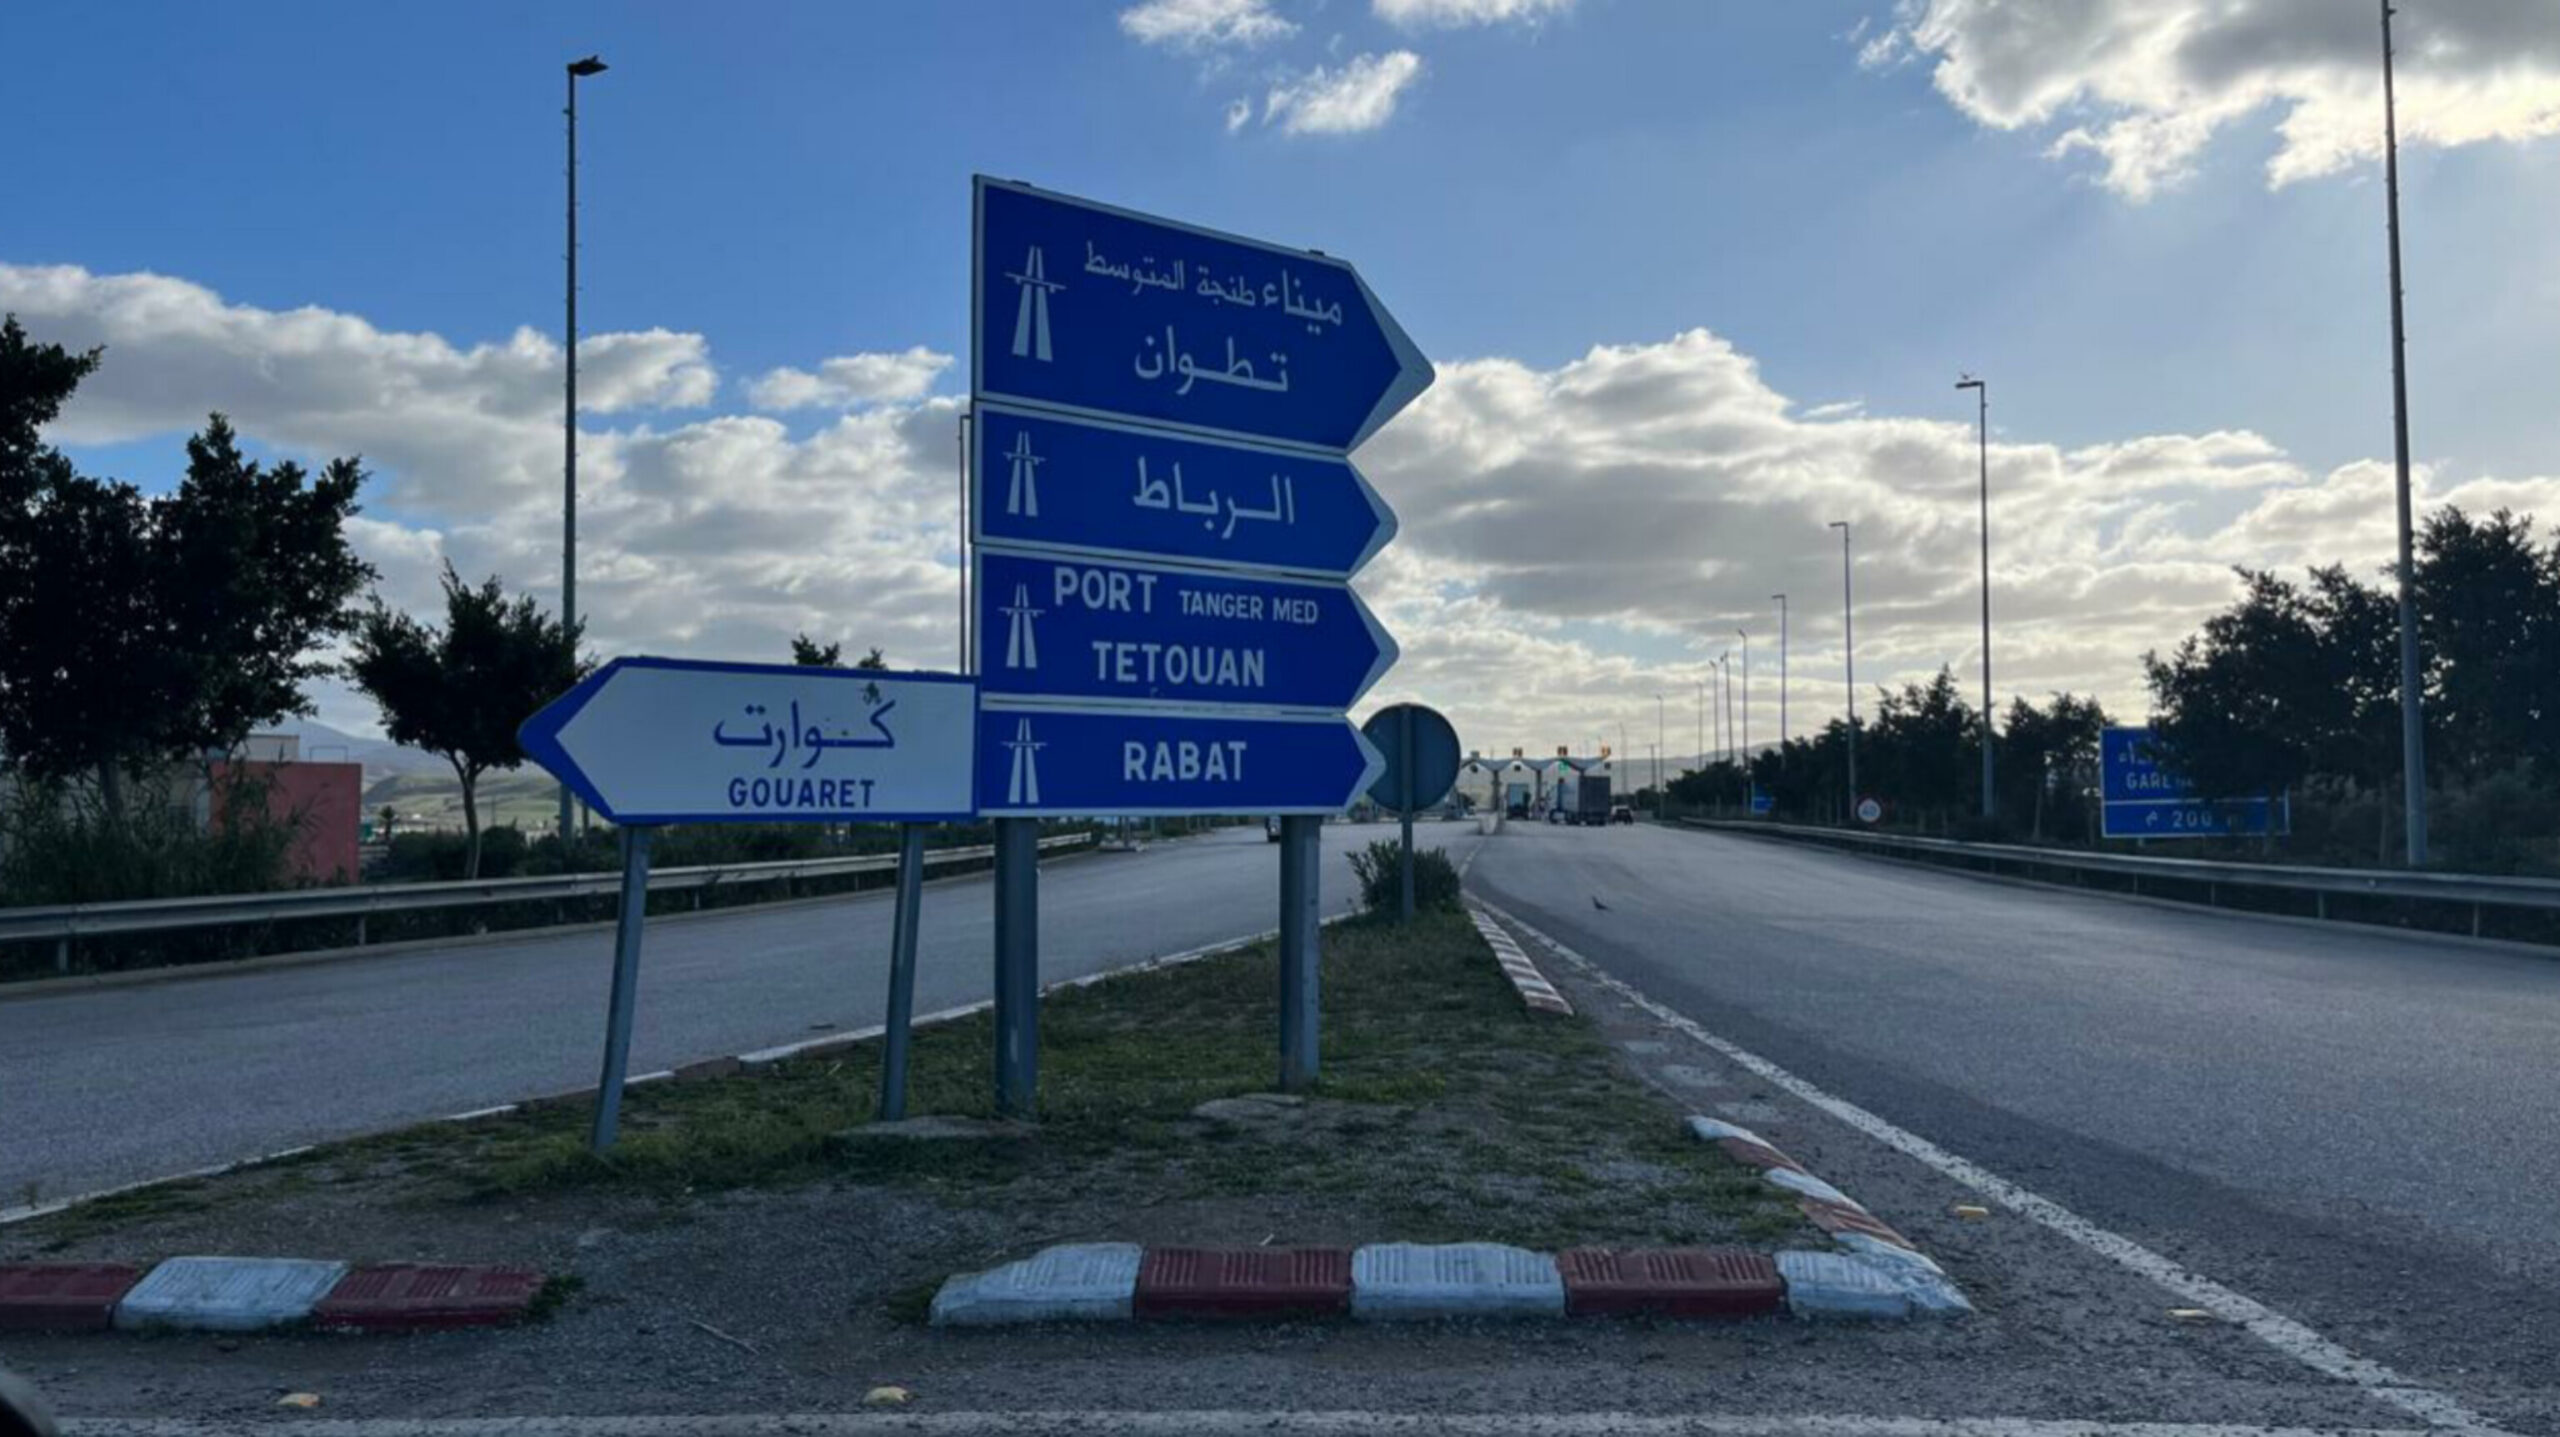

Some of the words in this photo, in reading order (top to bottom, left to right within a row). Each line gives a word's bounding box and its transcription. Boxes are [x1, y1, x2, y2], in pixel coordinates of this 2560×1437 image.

[1084, 240, 1185, 296] المتوسط
[1196, 265, 1256, 306] طنجة
[1262, 269, 1342, 335] ميناء
[1134, 324, 1289, 395] تطوان
[1133, 456, 1295, 539] الرباط
[1054, 566, 1158, 613] PORT
[1179, 590, 1264, 622] TANGER
[1273, 597, 1319, 625] MED
[1092, 641, 1265, 687] TETOUAN
[1124, 741, 1248, 781] RABAT
[728, 777, 875, 808] GOUARET
